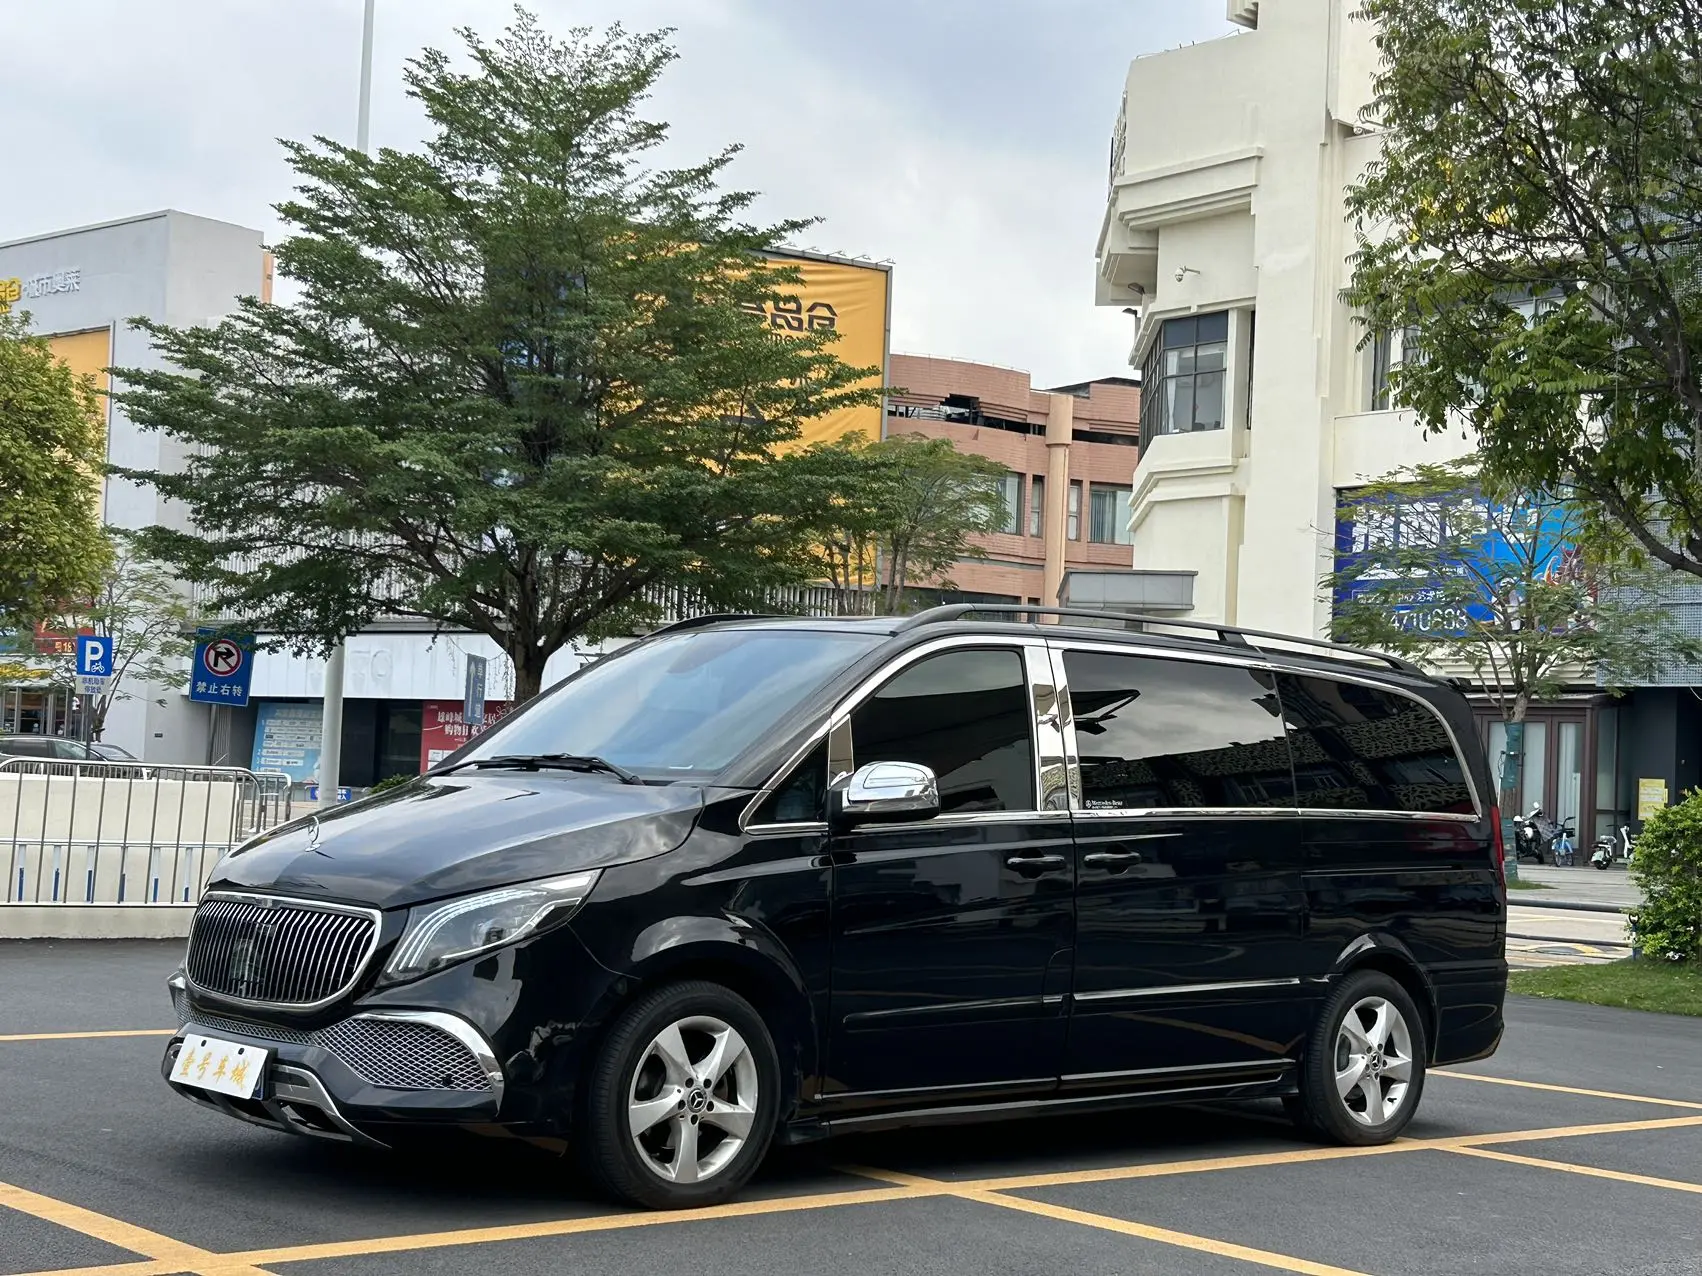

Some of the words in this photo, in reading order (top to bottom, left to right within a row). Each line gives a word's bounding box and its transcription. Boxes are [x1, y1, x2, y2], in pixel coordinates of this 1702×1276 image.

[84, 640, 104, 672] P
[196, 681, 243, 697] 禁止右转
